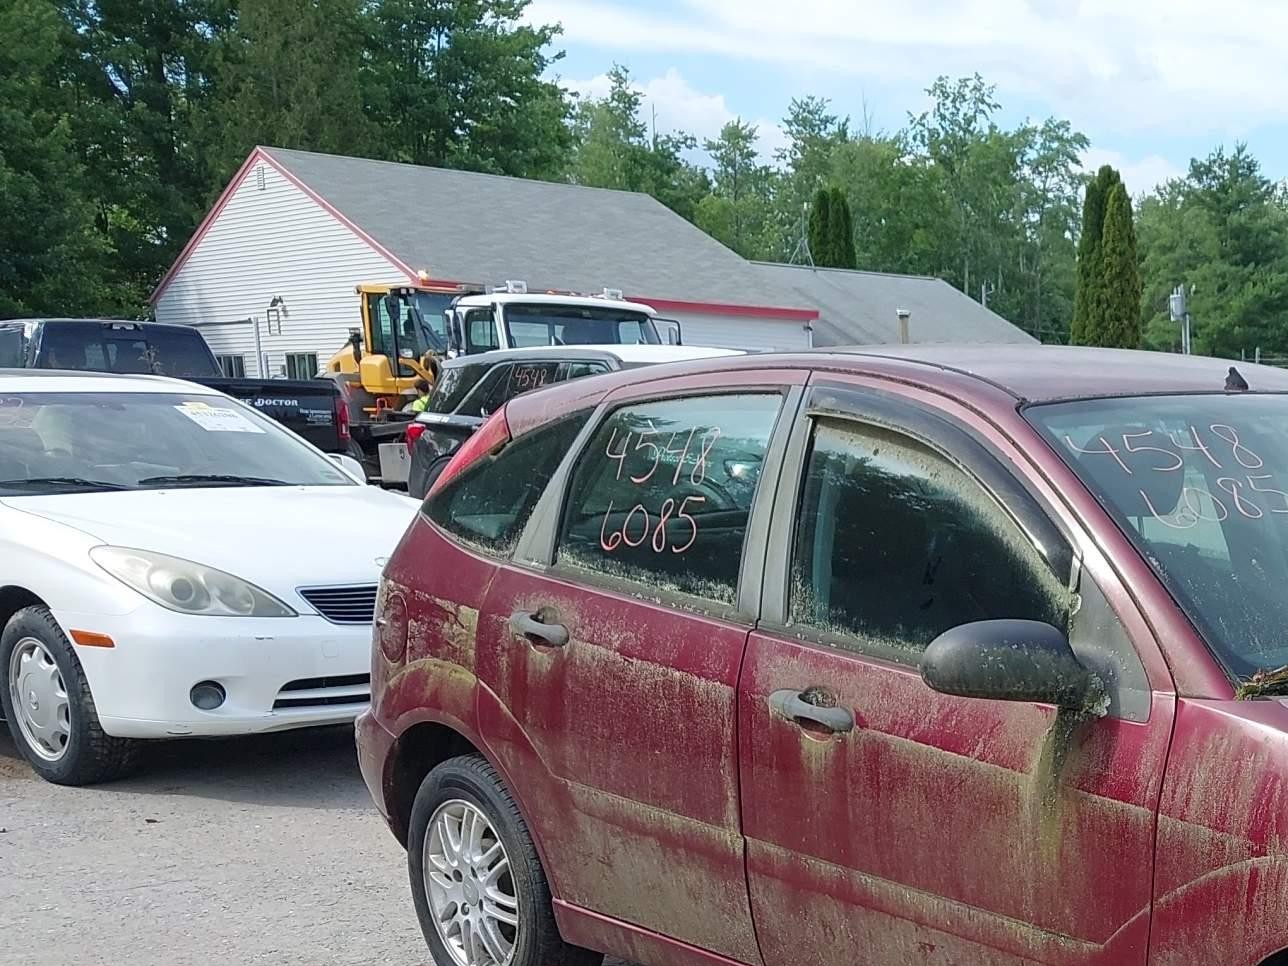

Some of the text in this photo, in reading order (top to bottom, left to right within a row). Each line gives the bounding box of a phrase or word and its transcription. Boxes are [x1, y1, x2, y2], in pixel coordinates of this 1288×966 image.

[515, 367, 547, 389] 4548
[606, 419, 721, 486] 4548
[1065, 424, 1264, 474] 4548
[600, 496, 705, 553] 6085
